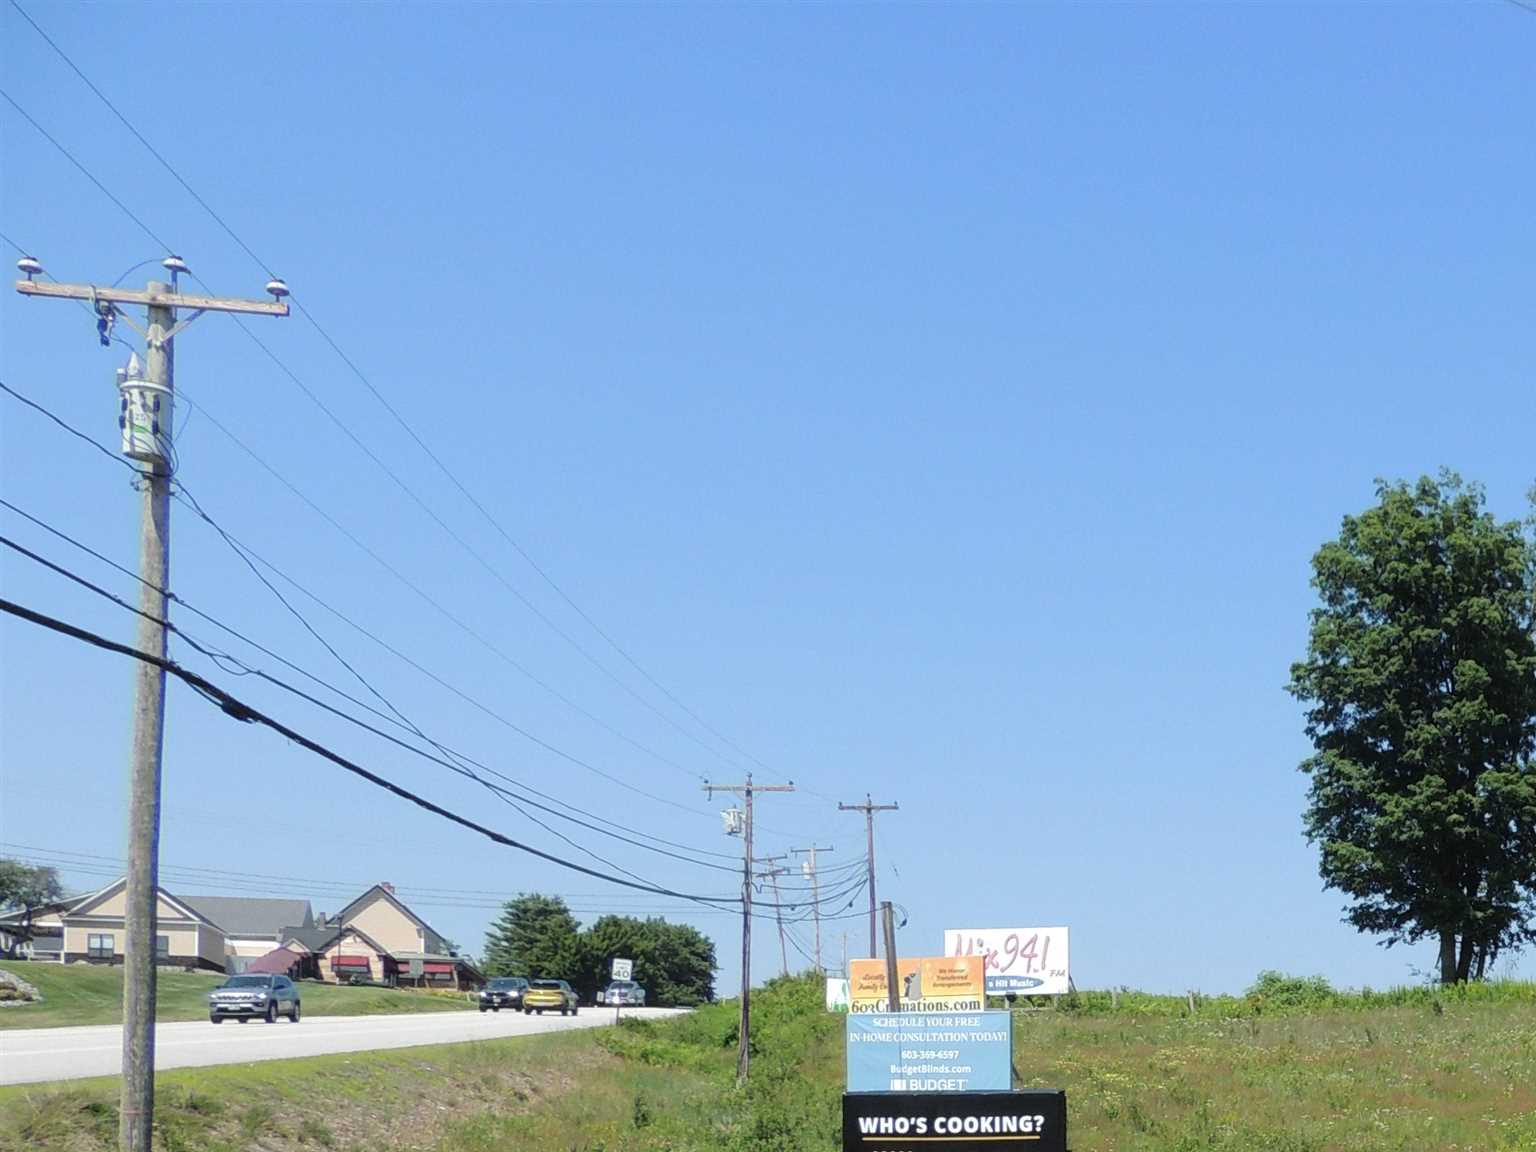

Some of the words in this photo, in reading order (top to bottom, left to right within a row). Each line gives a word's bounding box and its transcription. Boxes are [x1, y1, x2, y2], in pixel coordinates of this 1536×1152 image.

[1000, 933, 1051, 974] 94.1
[613, 969, 630, 978] 40
[995, 979, 1008, 988] Hit
[1009, 978, 1034, 988] Music
[851, 999, 981, 1014] 603Crmations.com
[873, 1017, 925, 1027] SCHEDULE
[926, 1017, 953, 1027] YOUR
[954, 1016, 981, 1026] FREE
[849, 1032, 893, 1042] IN-HOME
[894, 1032, 970, 1042] CONSULTATION
[970, 1031, 1007, 1041] TODAY!
[890, 1064, 972, 1076] BudgetBlinds.com
[909, 1079, 966, 1091] BUDGET
[858, 1117, 928, 1134] WHO'S
[934, 1115, 1045, 1133] COOKING?
